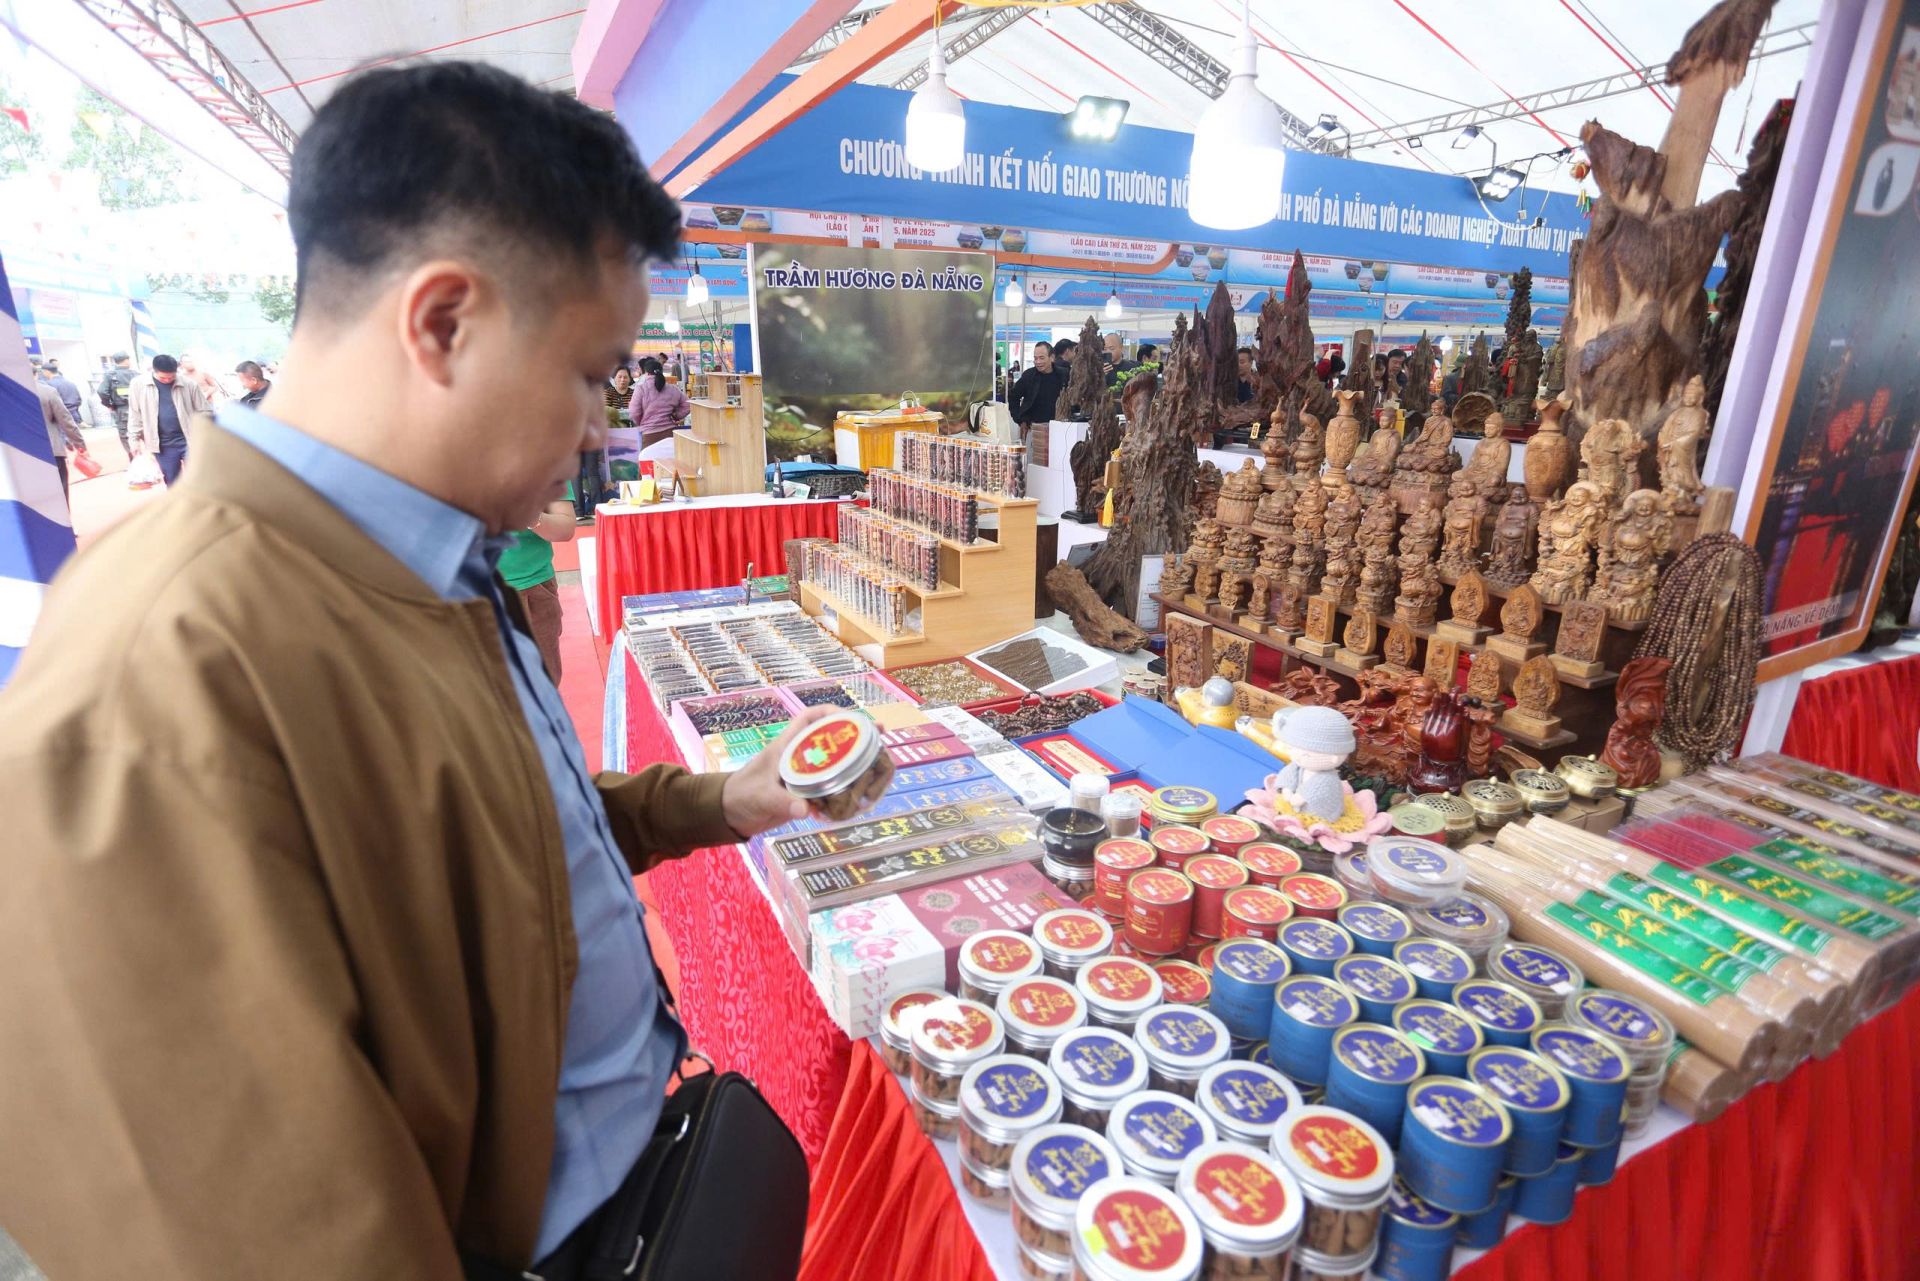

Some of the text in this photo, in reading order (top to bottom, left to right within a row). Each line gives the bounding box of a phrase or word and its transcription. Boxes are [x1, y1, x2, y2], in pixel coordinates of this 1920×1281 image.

[840, 138, 922, 180] CHƯƠN
[990, 147, 1022, 190] KẾT
[1028, 151, 1057, 194] NỐI
[1062, 164, 1101, 199] GIAO
[1105, 169, 1167, 207] THƯƠNG
[919, 228, 936, 237] 2025
[1294, 187, 1322, 224] PHỐ
[1323, 193, 1340, 227] ĐÀ
[1343, 192, 1377, 231] NẴNG
[1380, 201, 1398, 233] VỚI
[1400, 204, 1422, 236] CÁC
[1425, 211, 1460, 240] DOANH
[1462, 214, 1500, 249] NGHIỆP
[1552, 228, 1567, 257] TẠI
[764, 260, 984, 291] TRẦM HƯƠNG ĐÀ NẴNG
